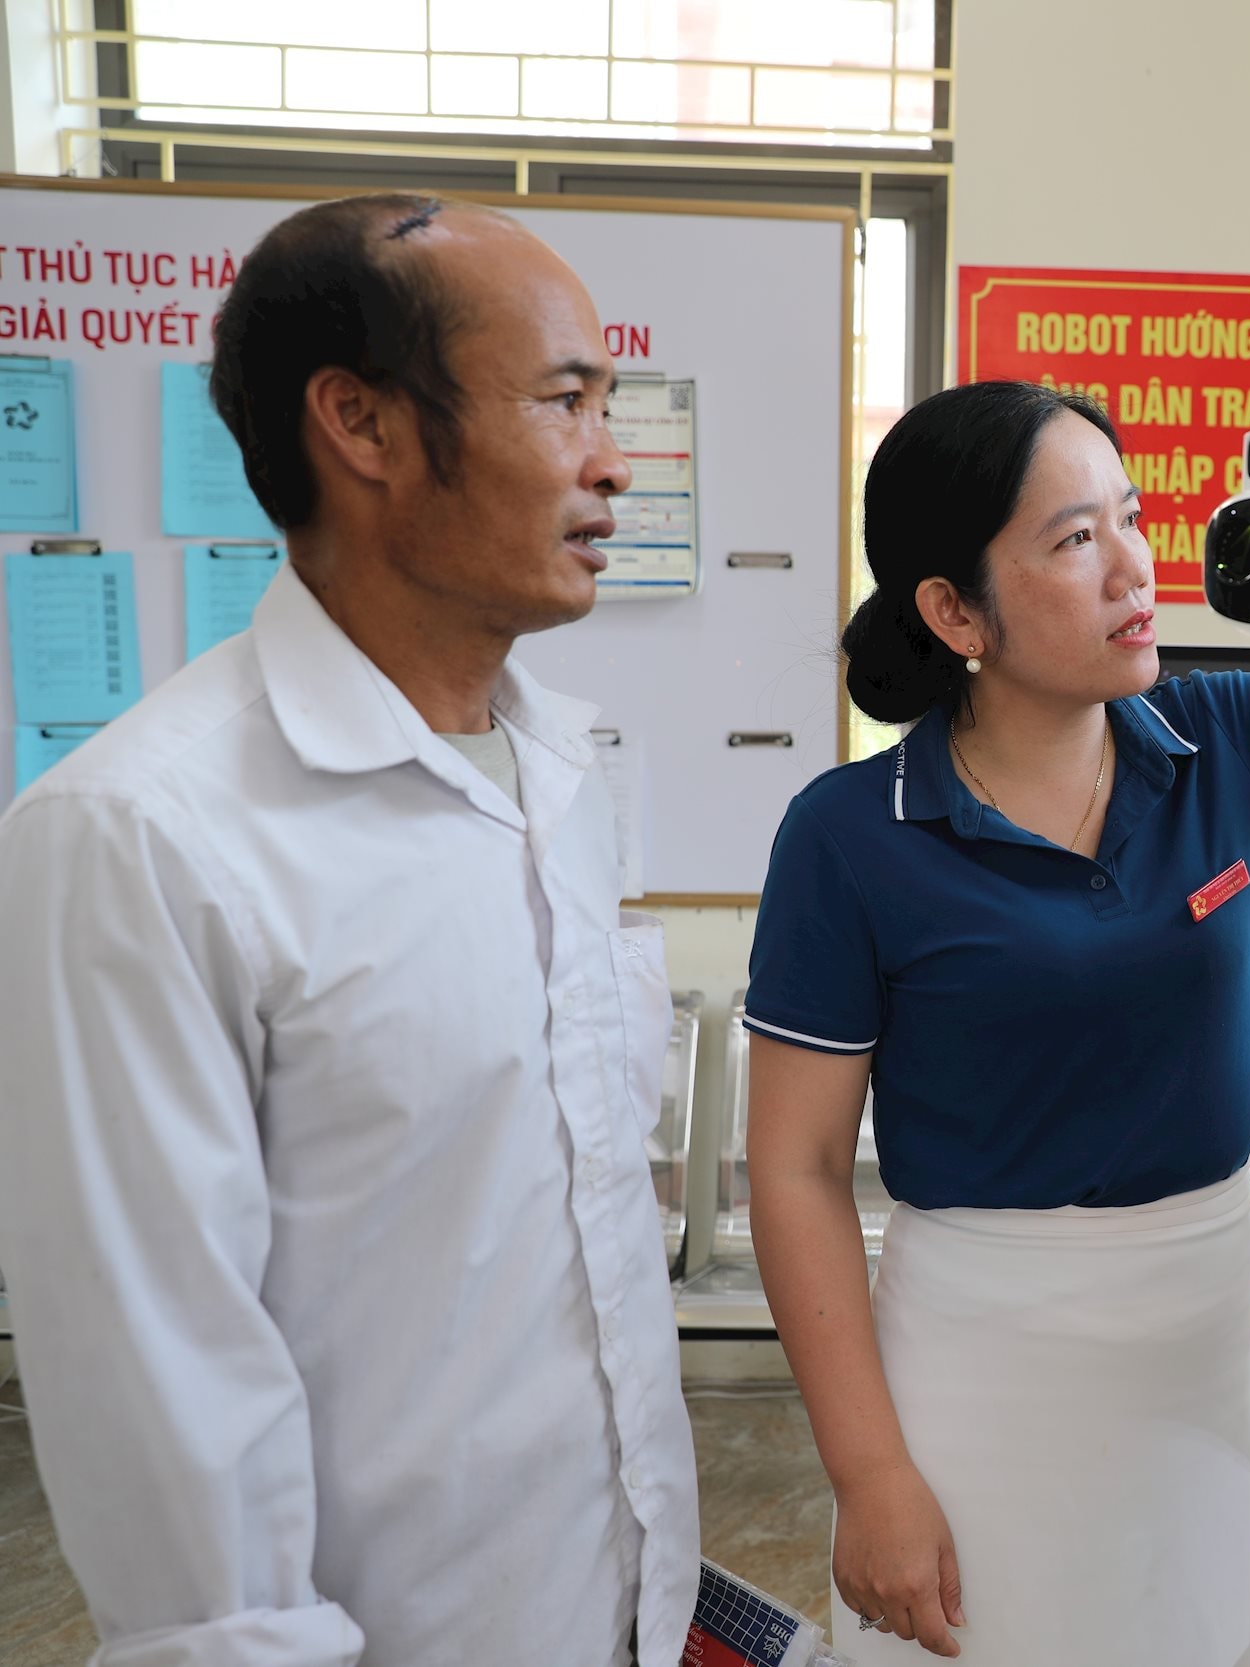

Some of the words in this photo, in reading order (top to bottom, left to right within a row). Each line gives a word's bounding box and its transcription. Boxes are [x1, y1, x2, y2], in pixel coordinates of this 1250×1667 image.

[16, 239, 92, 283] THỦ
[103, 251, 177, 295] TỤC
[191, 249, 236, 289] HÀ
[0, 297, 67, 341] GIẢI
[81, 301, 199, 351] QUYẾT
[604, 324, 650, 358] ƠN
[1017, 312, 1132, 356] ROBOT
[1119, 376, 1192, 426] DÂN
[1122, 446, 1214, 504] NHẬP
[1147, 517, 1206, 563] HÀ
[687, 1640, 704, 1656] Colle
[770, 1622, 793, 1644] DHB
[683, 1650, 704, 1667] Busin
